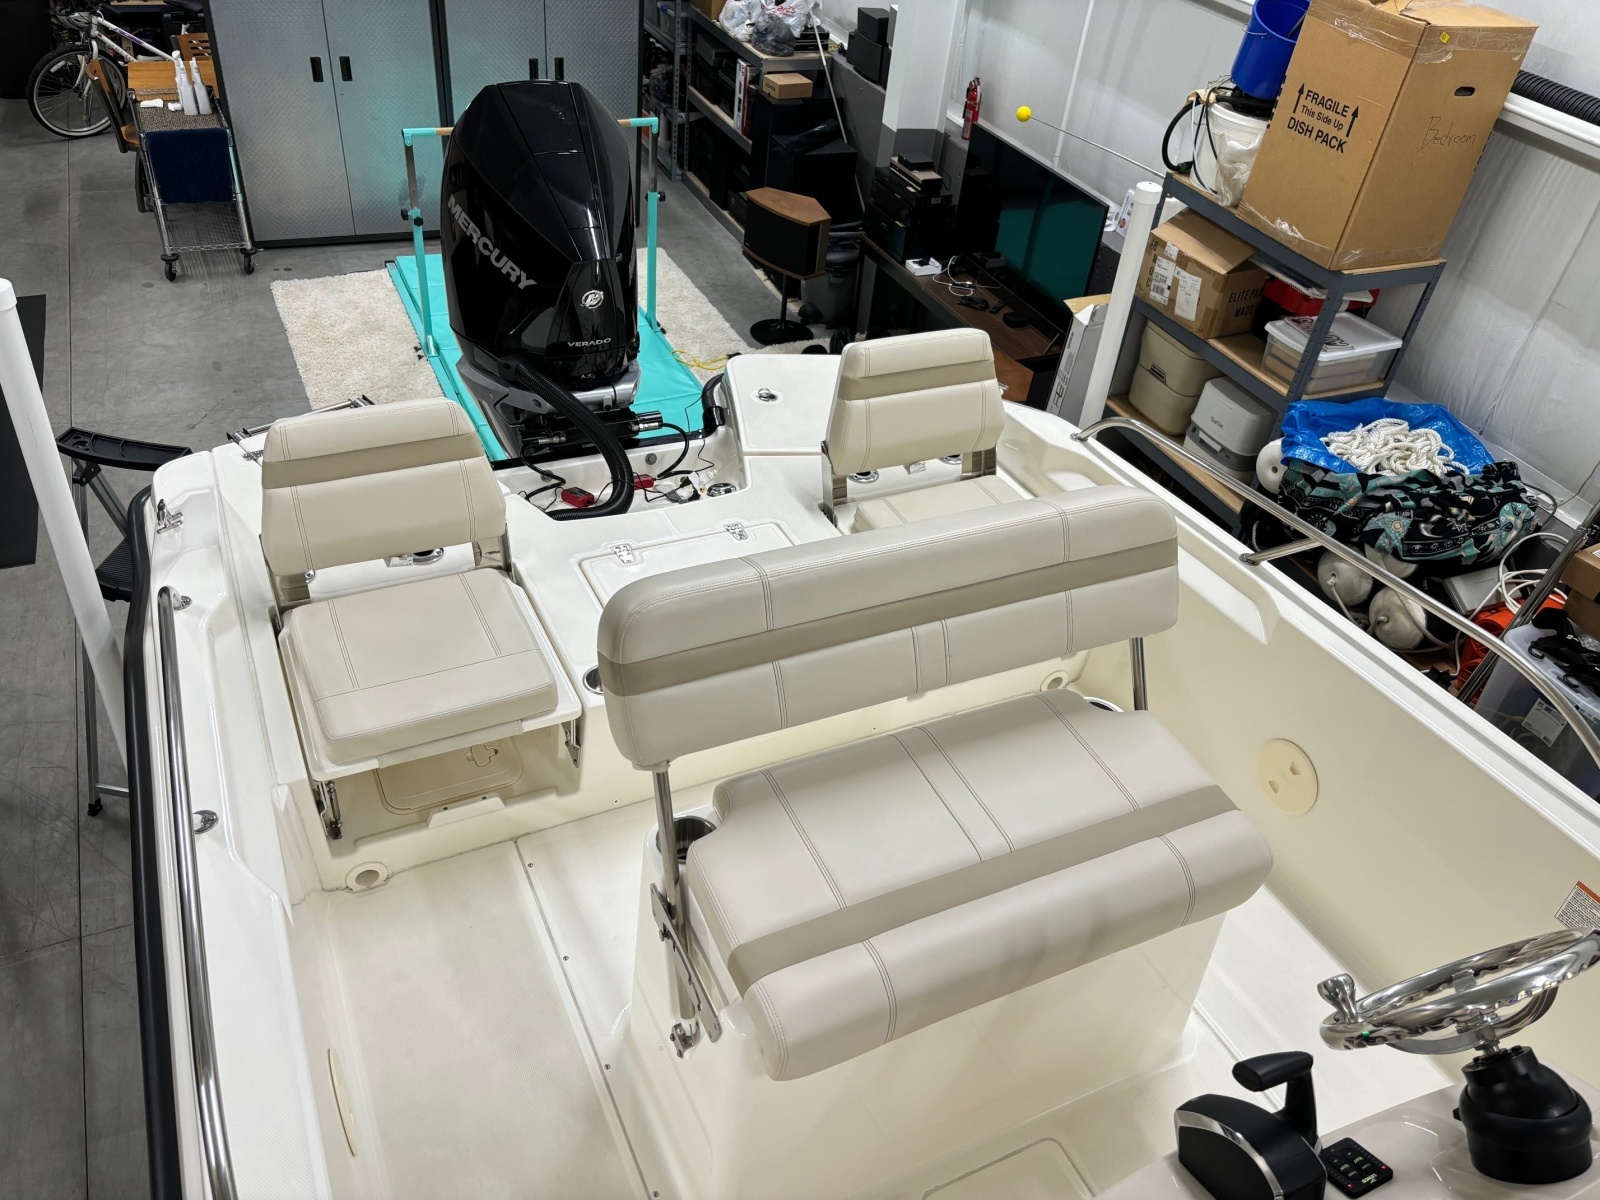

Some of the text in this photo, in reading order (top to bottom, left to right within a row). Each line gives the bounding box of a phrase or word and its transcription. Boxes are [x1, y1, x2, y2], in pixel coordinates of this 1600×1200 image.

[1301, 104, 1344, 131] This Side Up
[1304, 89, 1350, 118] FRAGILE
[1287, 116, 1348, 154] DISH PACK
[1417, 115, 1477, 153] Bedroom
[447, 194, 538, 290] MERCURY
[1229, 289, 1250, 303] ELITE
[567, 337, 611, 348] VERADO
